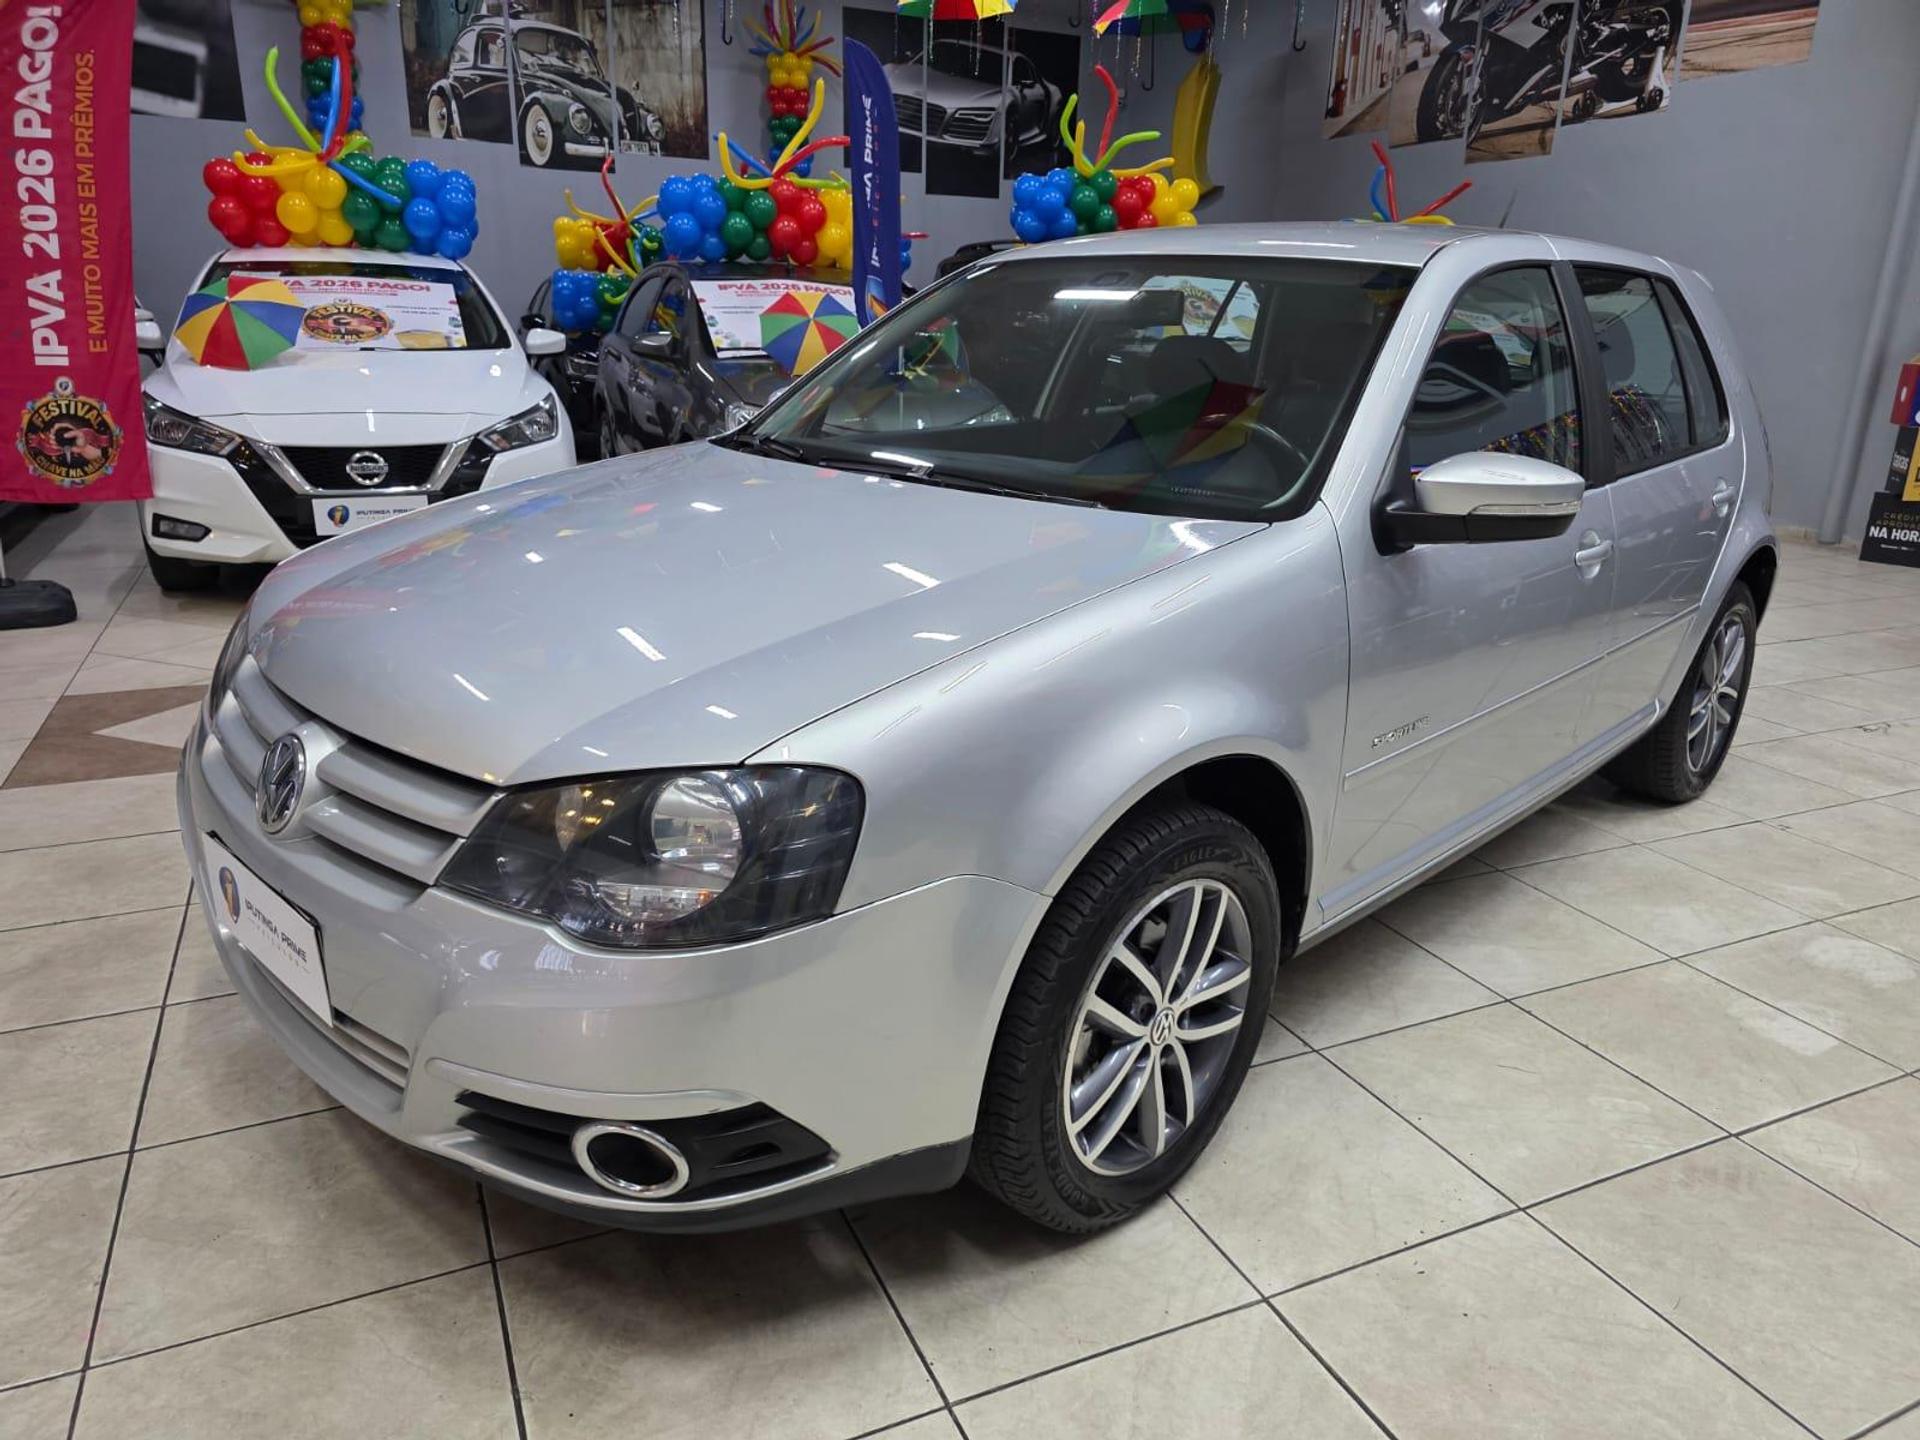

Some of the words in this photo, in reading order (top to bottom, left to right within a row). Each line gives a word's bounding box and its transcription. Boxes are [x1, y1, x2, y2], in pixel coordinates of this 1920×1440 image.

[13, 5, 63, 139] PAGO!
[69, 50, 95, 158] PRÊMIOS.
[77, 163, 96, 198] EM
[15, 148, 61, 260] 2026
[79, 203, 99, 259] MAIS
[83, 264, 106, 334] MUITO
[310, 279, 362, 288] 2026
[368, 281, 431, 292] PAGO!
[717, 283, 757, 292] IPVA
[760, 282, 800, 292] 2026
[26, 269, 70, 366] IPVA
[89, 338, 108, 353] E
[33, 399, 102, 429] FESTIVAL
[1869, 525, 1888, 539] NA
[1891, 528, 1920, 543] HOR
